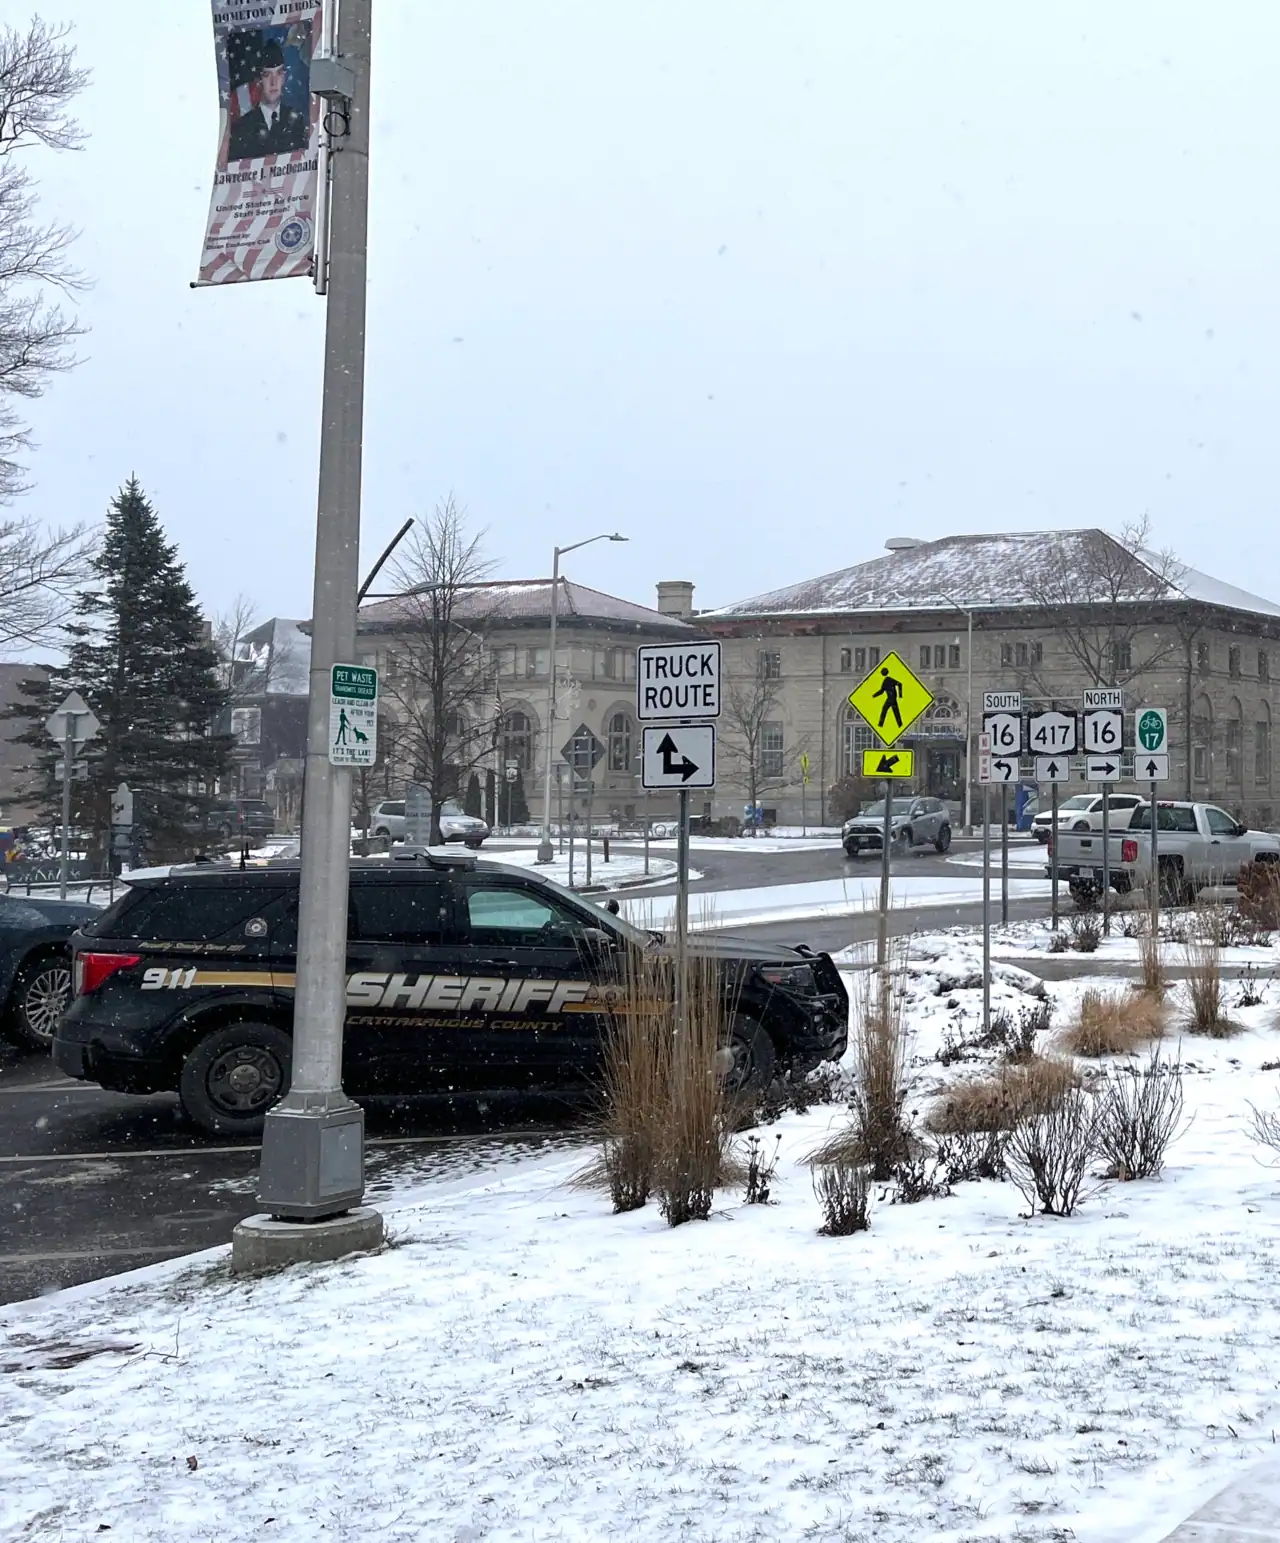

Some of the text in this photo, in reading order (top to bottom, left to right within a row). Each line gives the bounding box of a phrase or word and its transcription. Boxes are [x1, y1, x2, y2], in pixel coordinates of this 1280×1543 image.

[213, 0, 321, 23] HOMETOWN HEROES
[214, 158, 318, 185] Lawrence J. MacDonald
[215, 203, 243, 212] United
[245, 200, 271, 209] States
[233, 209, 254, 219] Staff
[642, 653, 714, 679] TRUCK
[336, 671, 373, 684] PET WASTE
[645, 684, 715, 710] ROUTE
[985, 694, 1020, 708] SOUTH
[1085, 691, 1121, 705] NORTH
[992, 723, 1015, 746] 16
[1034, 725, 1070, 745] 417
[1092, 721, 1116, 744] 16
[1144, 733, 1159, 748] 17
[141, 967, 197, 990] 911
[346, 972, 591, 1013] SHERIFF
[346, 1015, 564, 1031] CATTARAUGUS COUNTY
